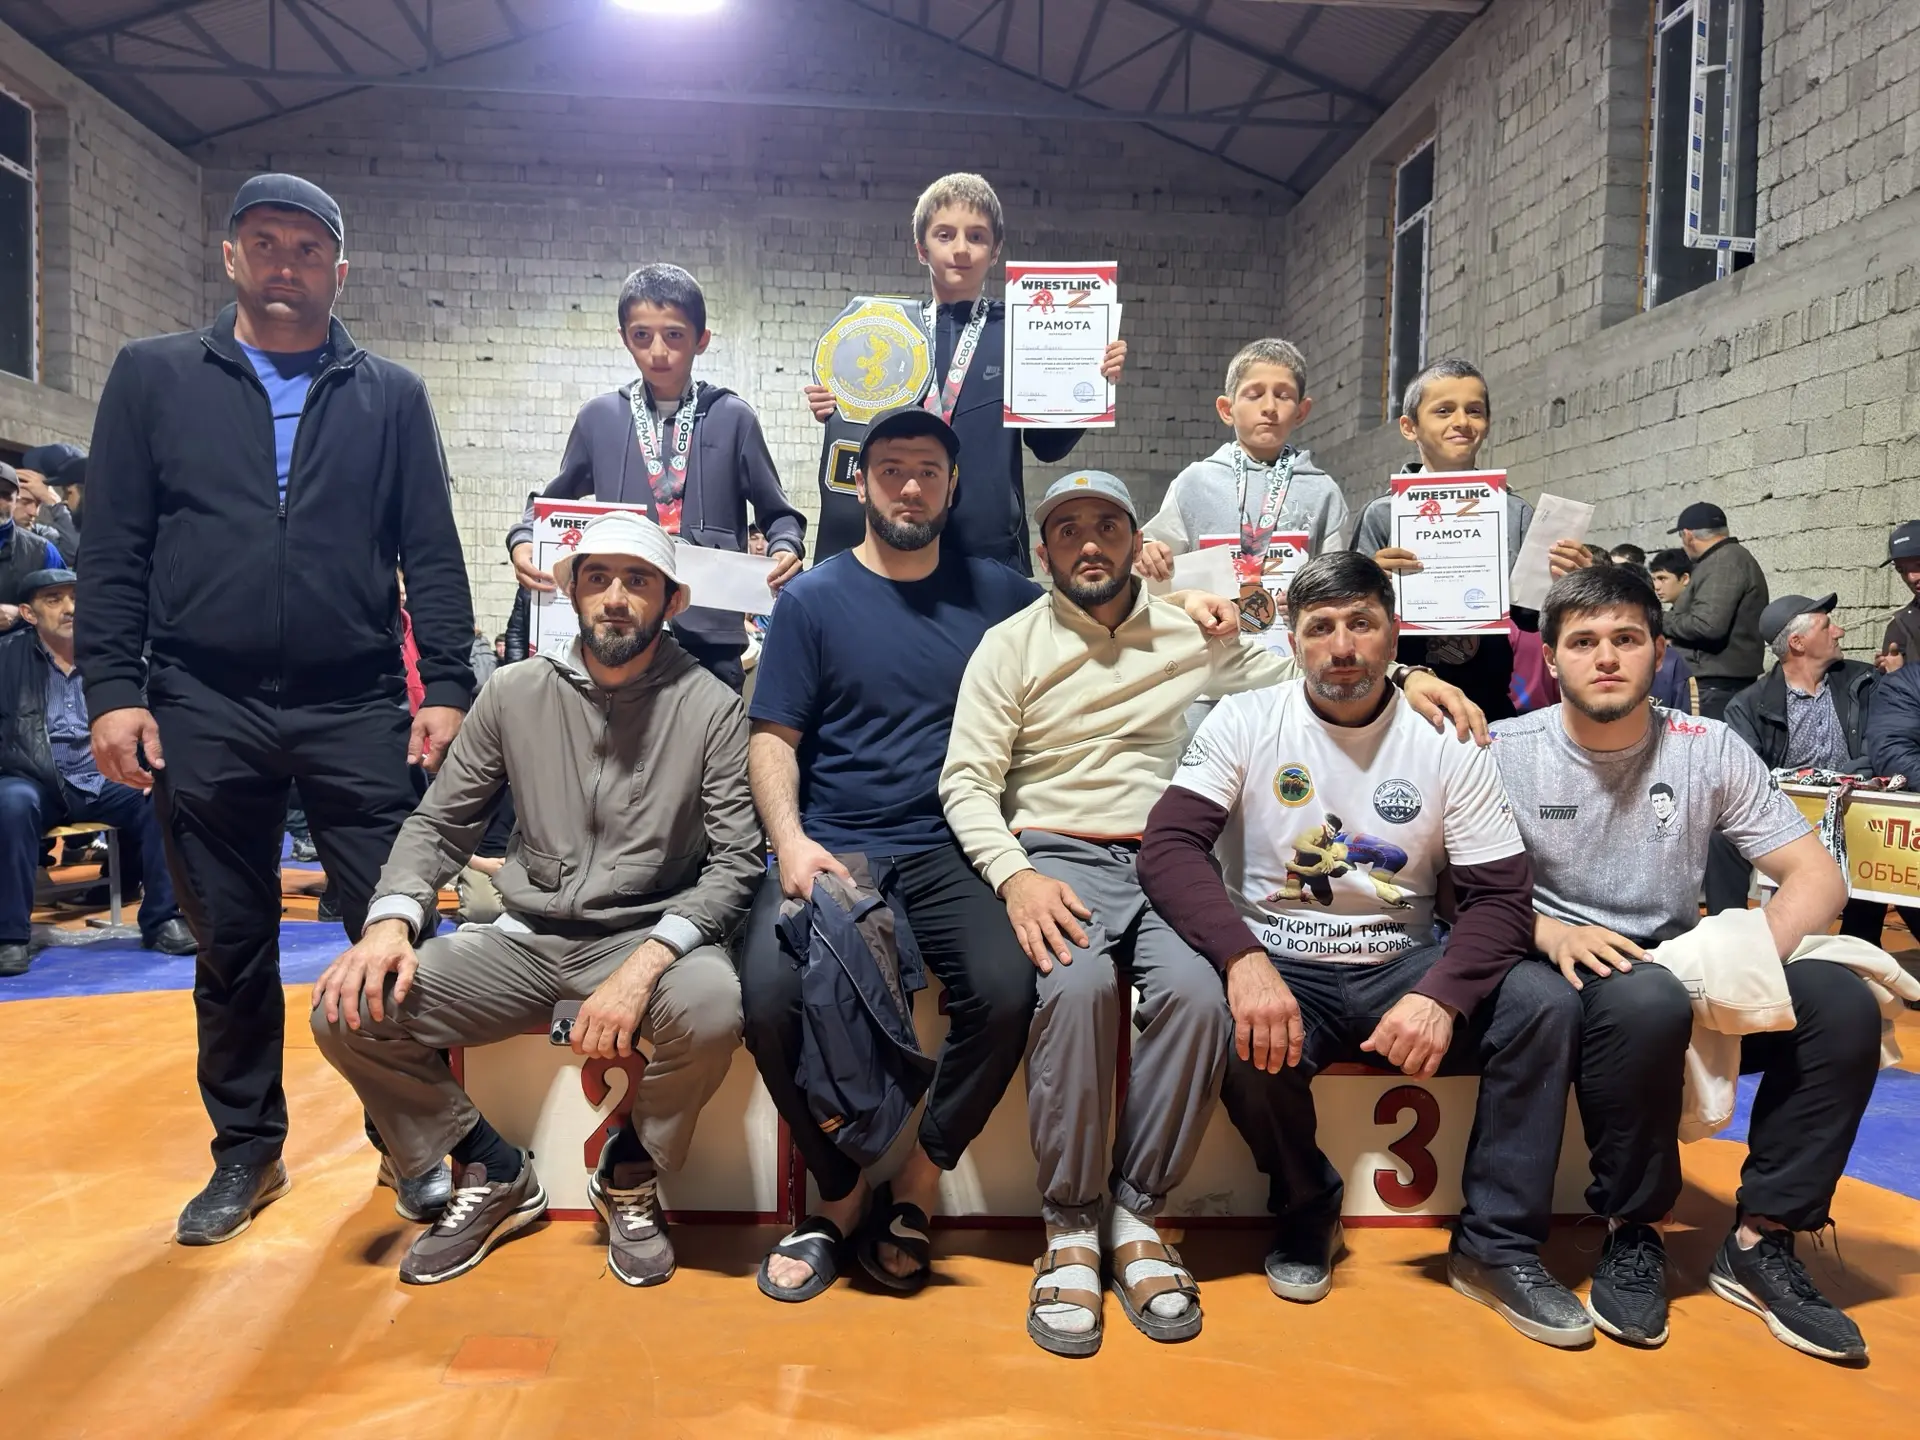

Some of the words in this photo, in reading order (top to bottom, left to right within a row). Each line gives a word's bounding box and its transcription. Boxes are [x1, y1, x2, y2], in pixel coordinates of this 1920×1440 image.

[1021, 280, 1101, 290] WRESTLING
[1028, 320, 1092, 330] ГРАМОТА
[957, 340, 973, 366] СВО
[632, 393, 655, 458] ДЖУРМУТ
[677, 422, 690, 452] СВО
[1266, 457, 1289, 511] ДЖУРМУТ
[1407, 488, 1491, 501] WRESTLING
[1416, 528, 1482, 541] ГРАМОТА
[1858, 860, 1920, 890] ОБЪЕ
[1266, 914, 1352, 937] ОТКРЫТЫЙ
[1262, 929, 1282, 946] ПО
[1287, 938, 1362, 954] ВОЛЬНОЙ
[1368, 936, 1413, 954] БОРЬБЕ
[581, 1049, 648, 1170] 2
[1374, 1085, 1440, 1209] 3
